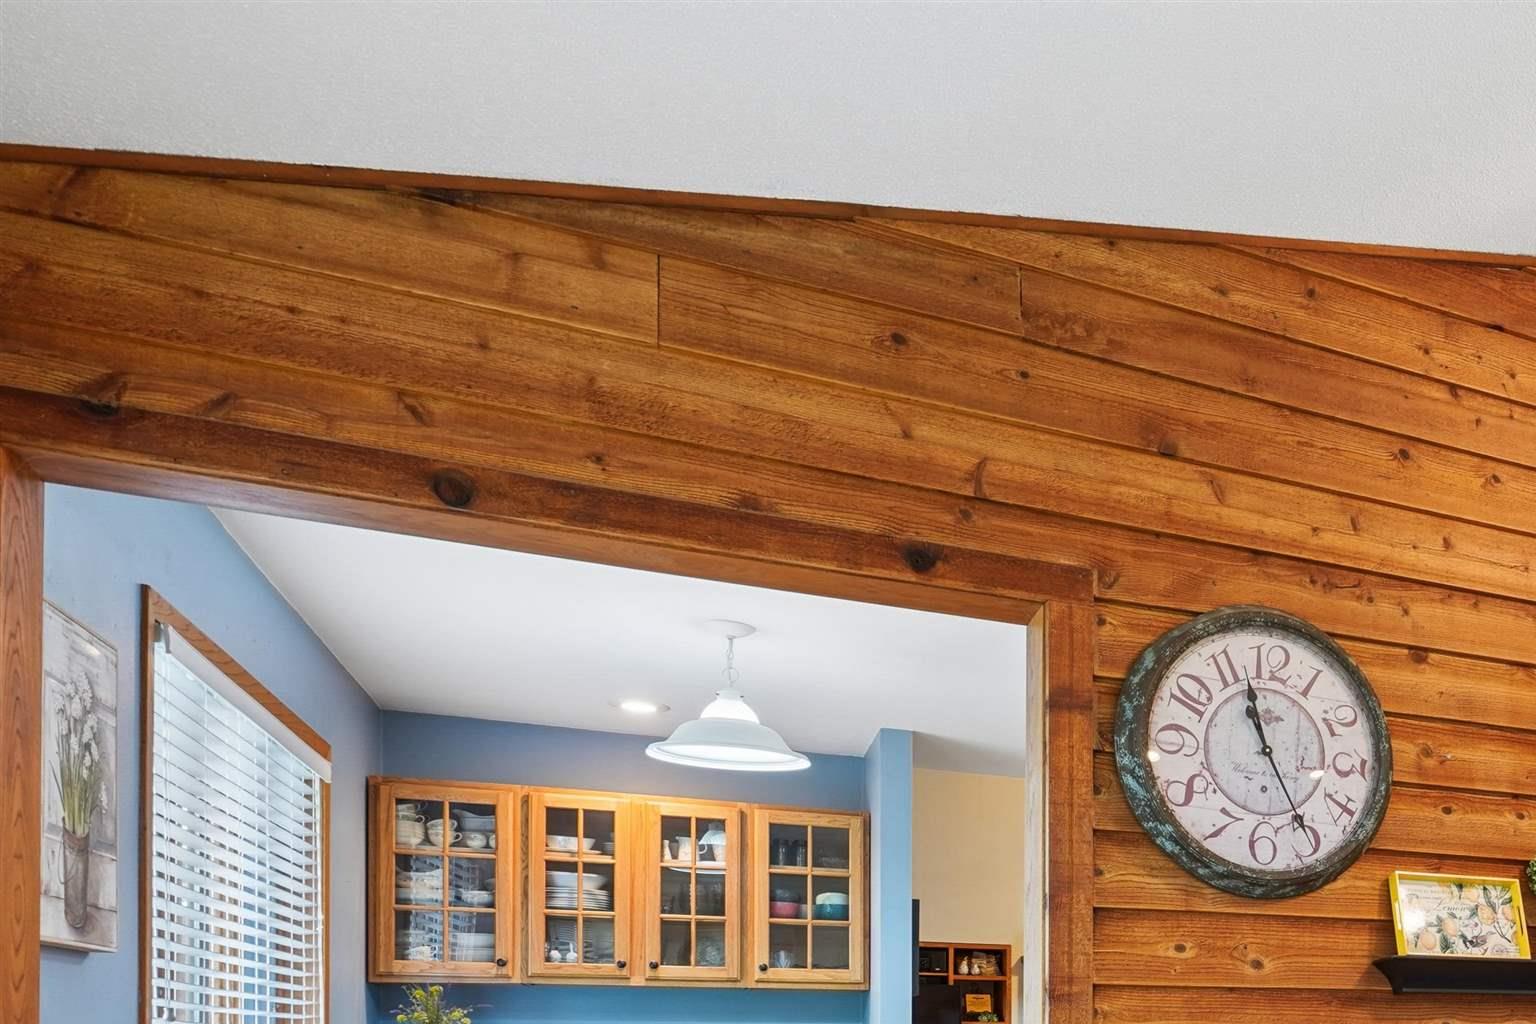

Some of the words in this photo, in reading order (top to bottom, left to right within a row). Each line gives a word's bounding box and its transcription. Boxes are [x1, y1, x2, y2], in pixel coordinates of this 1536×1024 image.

[1205, 643, 1247, 692] 11
[1248, 643, 1291, 685] 12
[1168, 672, 1214, 723] 10
[1296, 666, 1324, 700] 1
[1321, 703, 1358, 738] 2
[1154, 723, 1199, 757] 9
[1332, 751, 1368, 781] 3
[1165, 772, 1209, 807] 8
[1323, 788, 1358, 825] 4
[1203, 807, 1245, 841] 7
[1290, 812, 1321, 858] 5
[1249, 821, 1278, 865] 6
